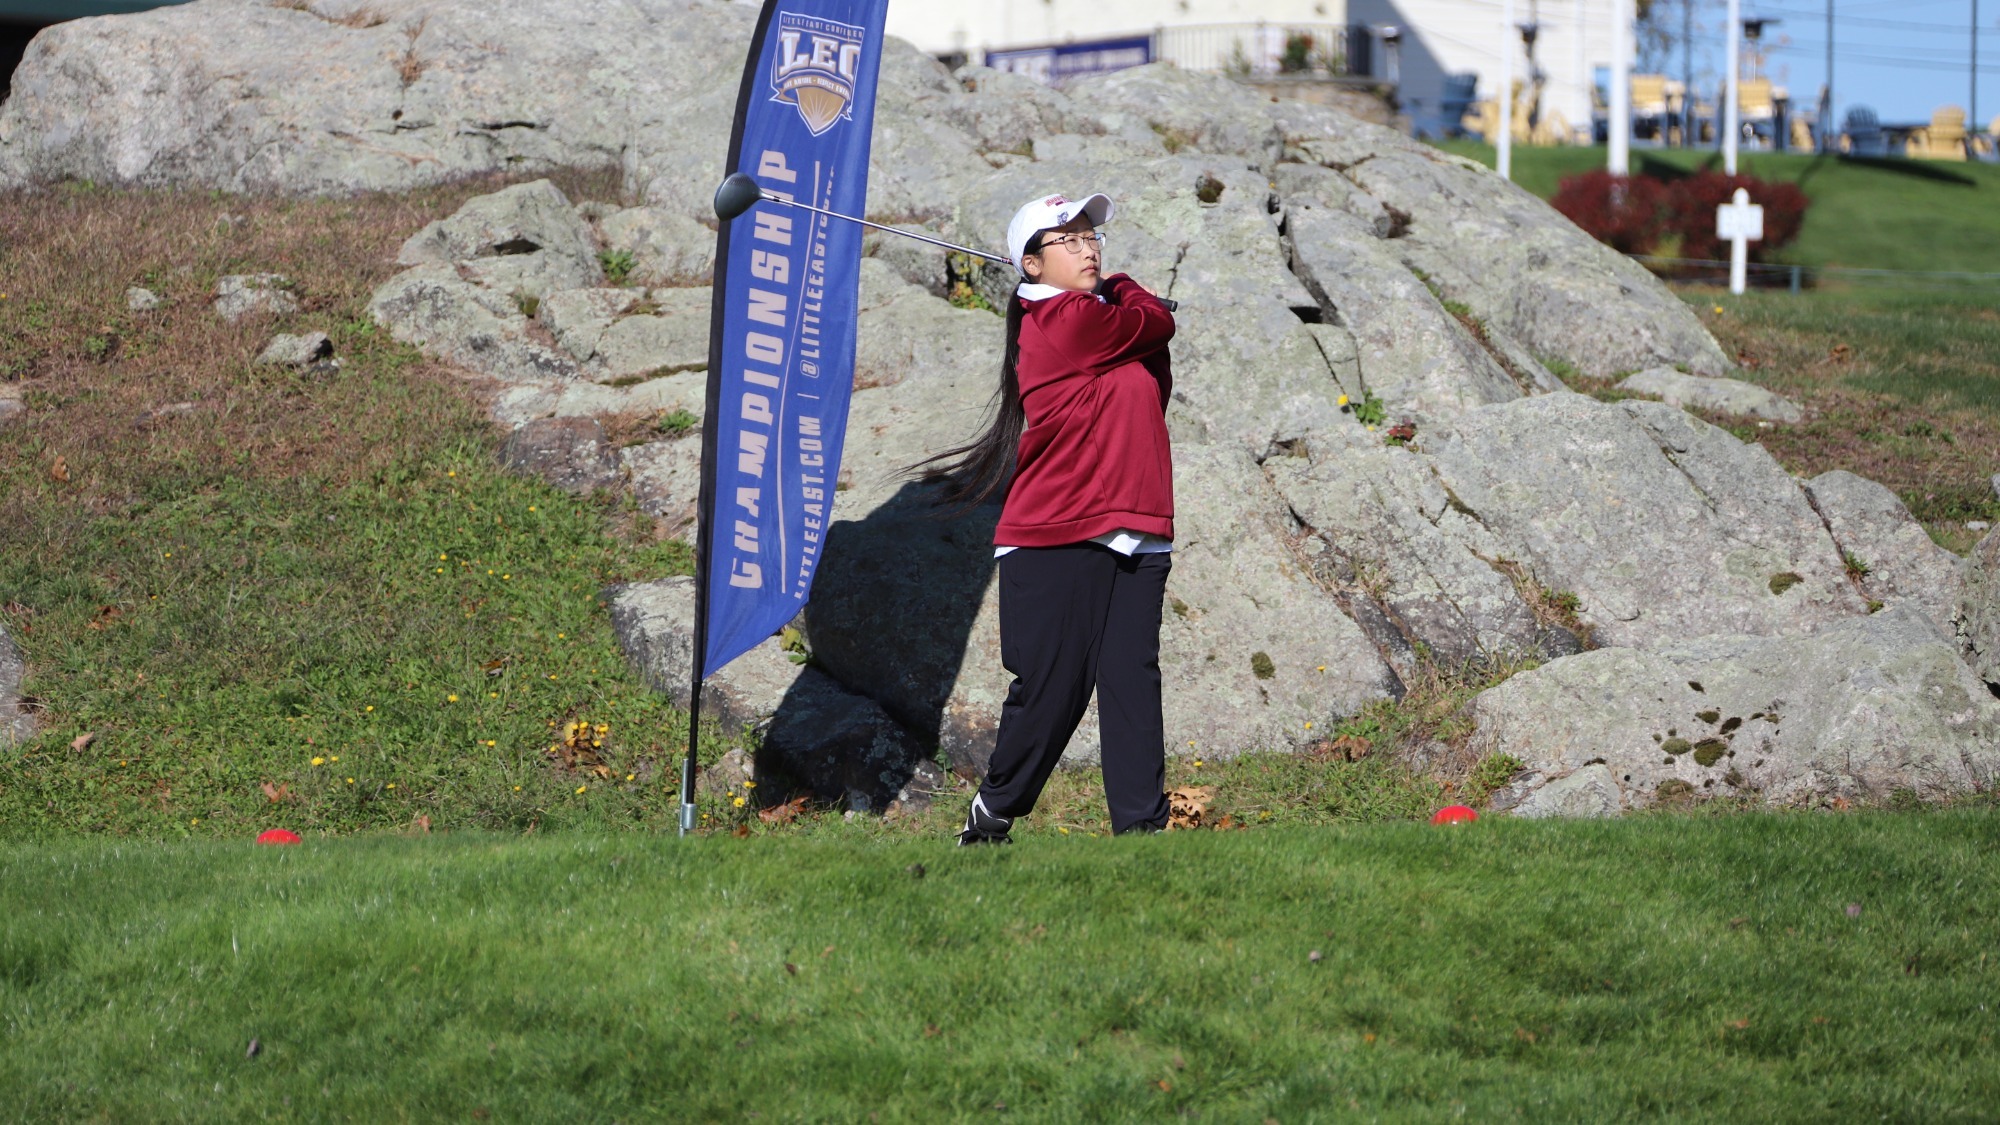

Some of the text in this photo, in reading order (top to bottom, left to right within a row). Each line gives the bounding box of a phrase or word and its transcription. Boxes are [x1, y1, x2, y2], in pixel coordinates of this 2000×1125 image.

[778, 31, 860, 83] LEC
[729, 150, 797, 588] CHAMPIONSHIP
[794, 415, 824, 599] LITTLEEAST.COM
